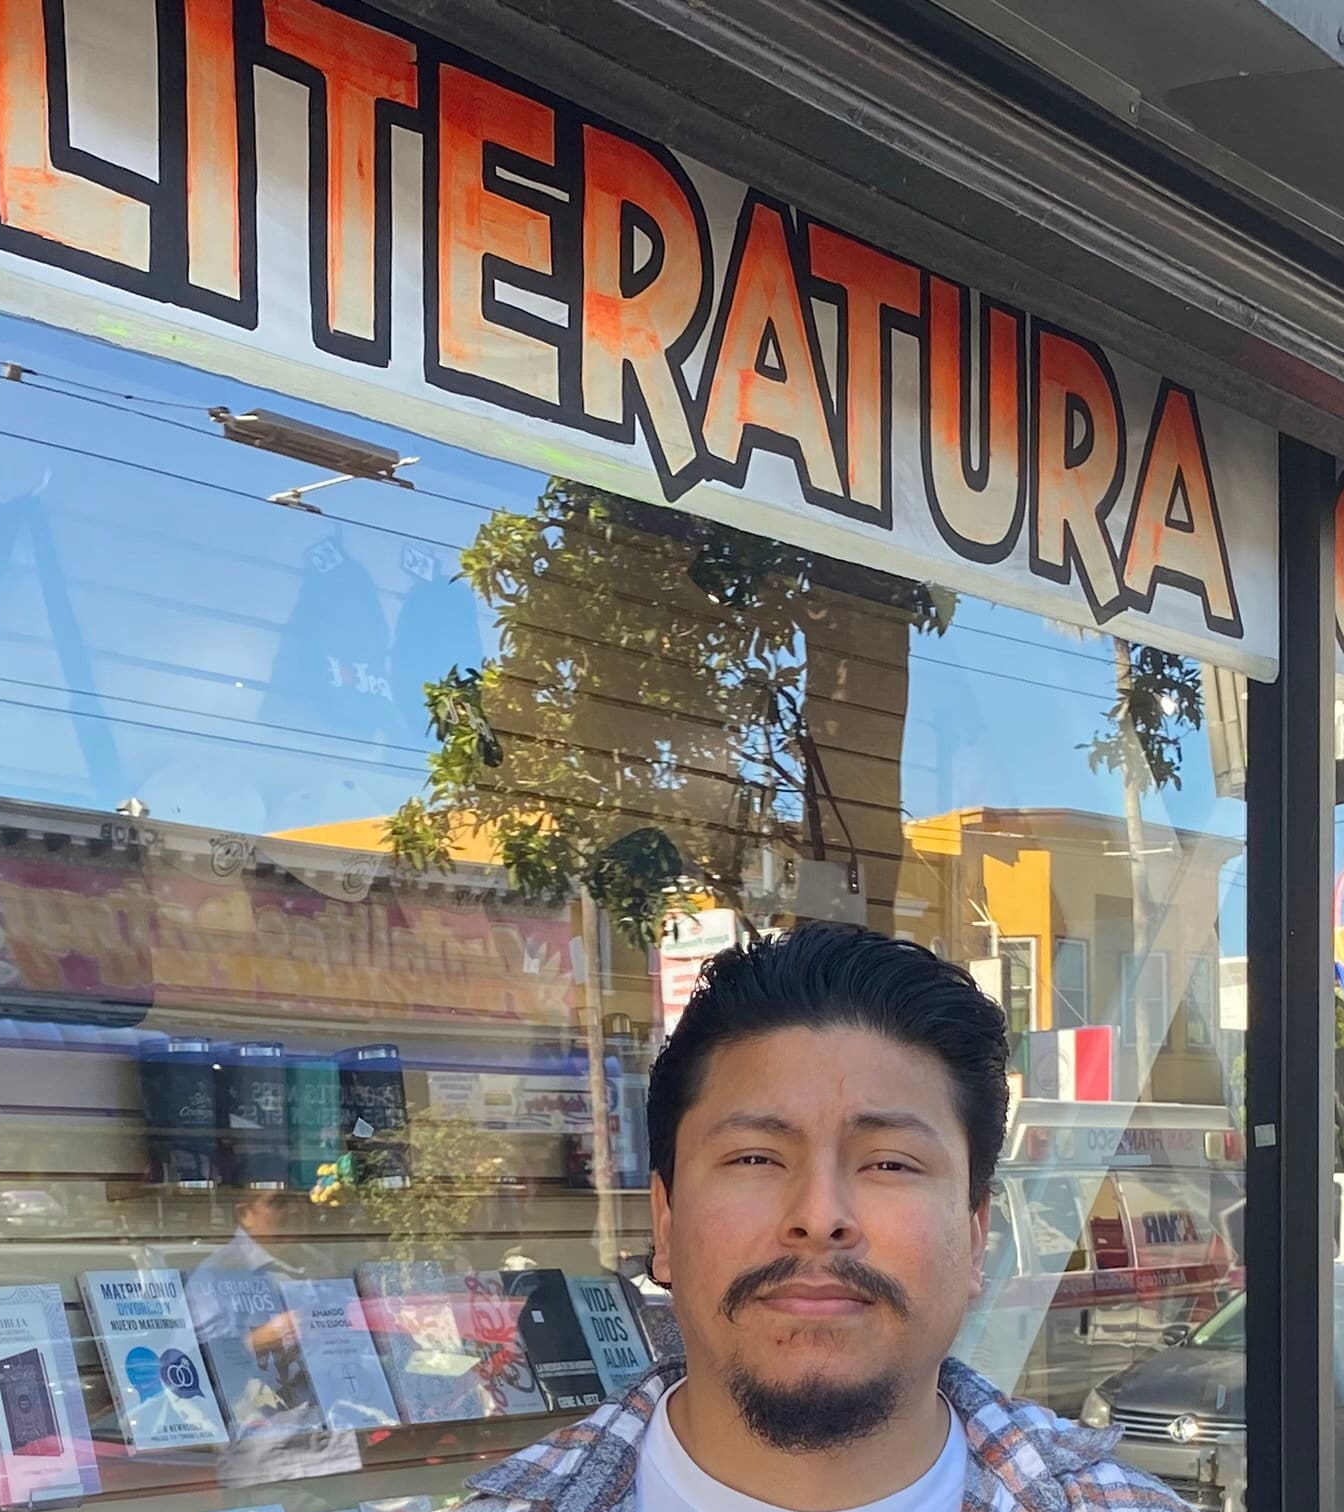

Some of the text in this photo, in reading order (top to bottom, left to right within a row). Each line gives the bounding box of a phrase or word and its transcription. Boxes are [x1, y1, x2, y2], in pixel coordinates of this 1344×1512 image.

[100, 1281, 177, 1300] MATRIMONIO
[580, 1287, 618, 1313] VIDA
[231, 1294, 274, 1314] HIJOS
[110, 1320, 137, 1331] NUEVO
[591, 1315, 628, 1342] DIOS
[606, 1347, 638, 1368] ALMA
